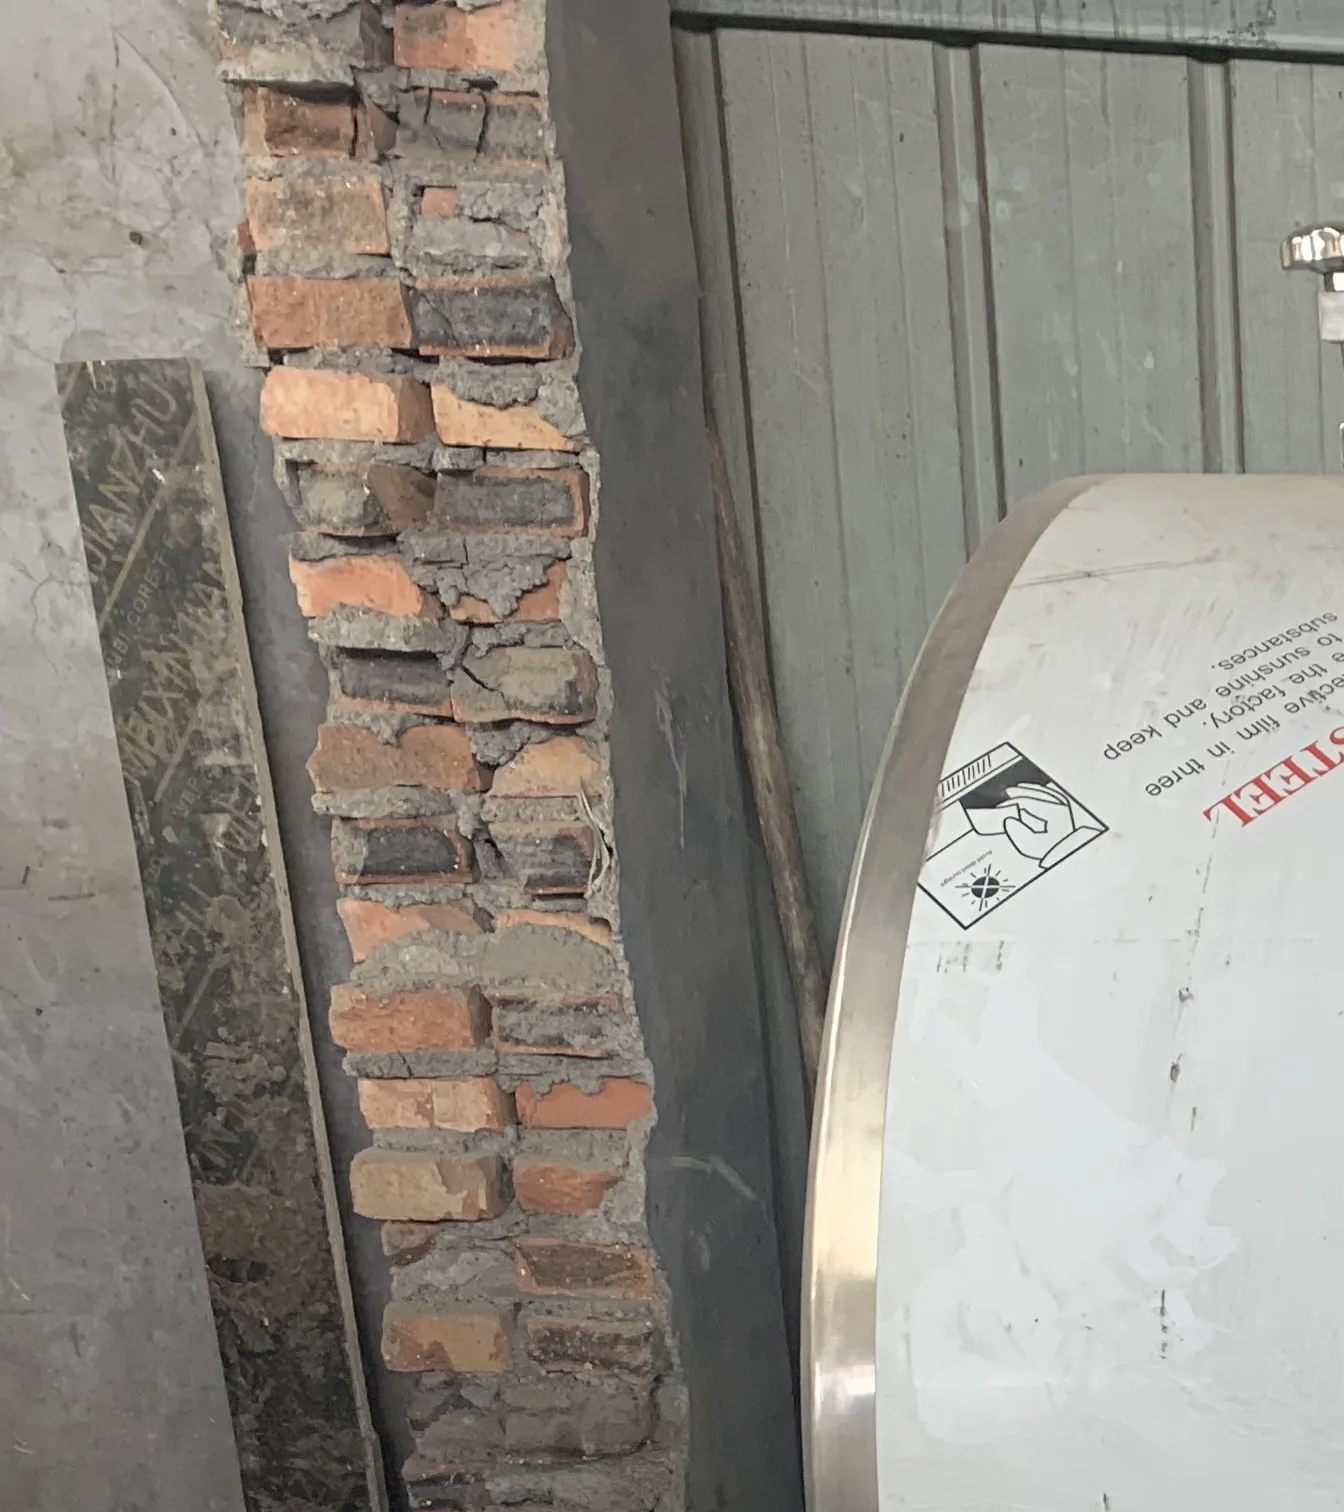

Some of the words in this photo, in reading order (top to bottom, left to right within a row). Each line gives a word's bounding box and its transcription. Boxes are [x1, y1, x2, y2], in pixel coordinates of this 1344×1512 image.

[1236, 714, 1282, 742] film
[1207, 740, 1236, 759] in
[1144, 757, 1206, 798] three
